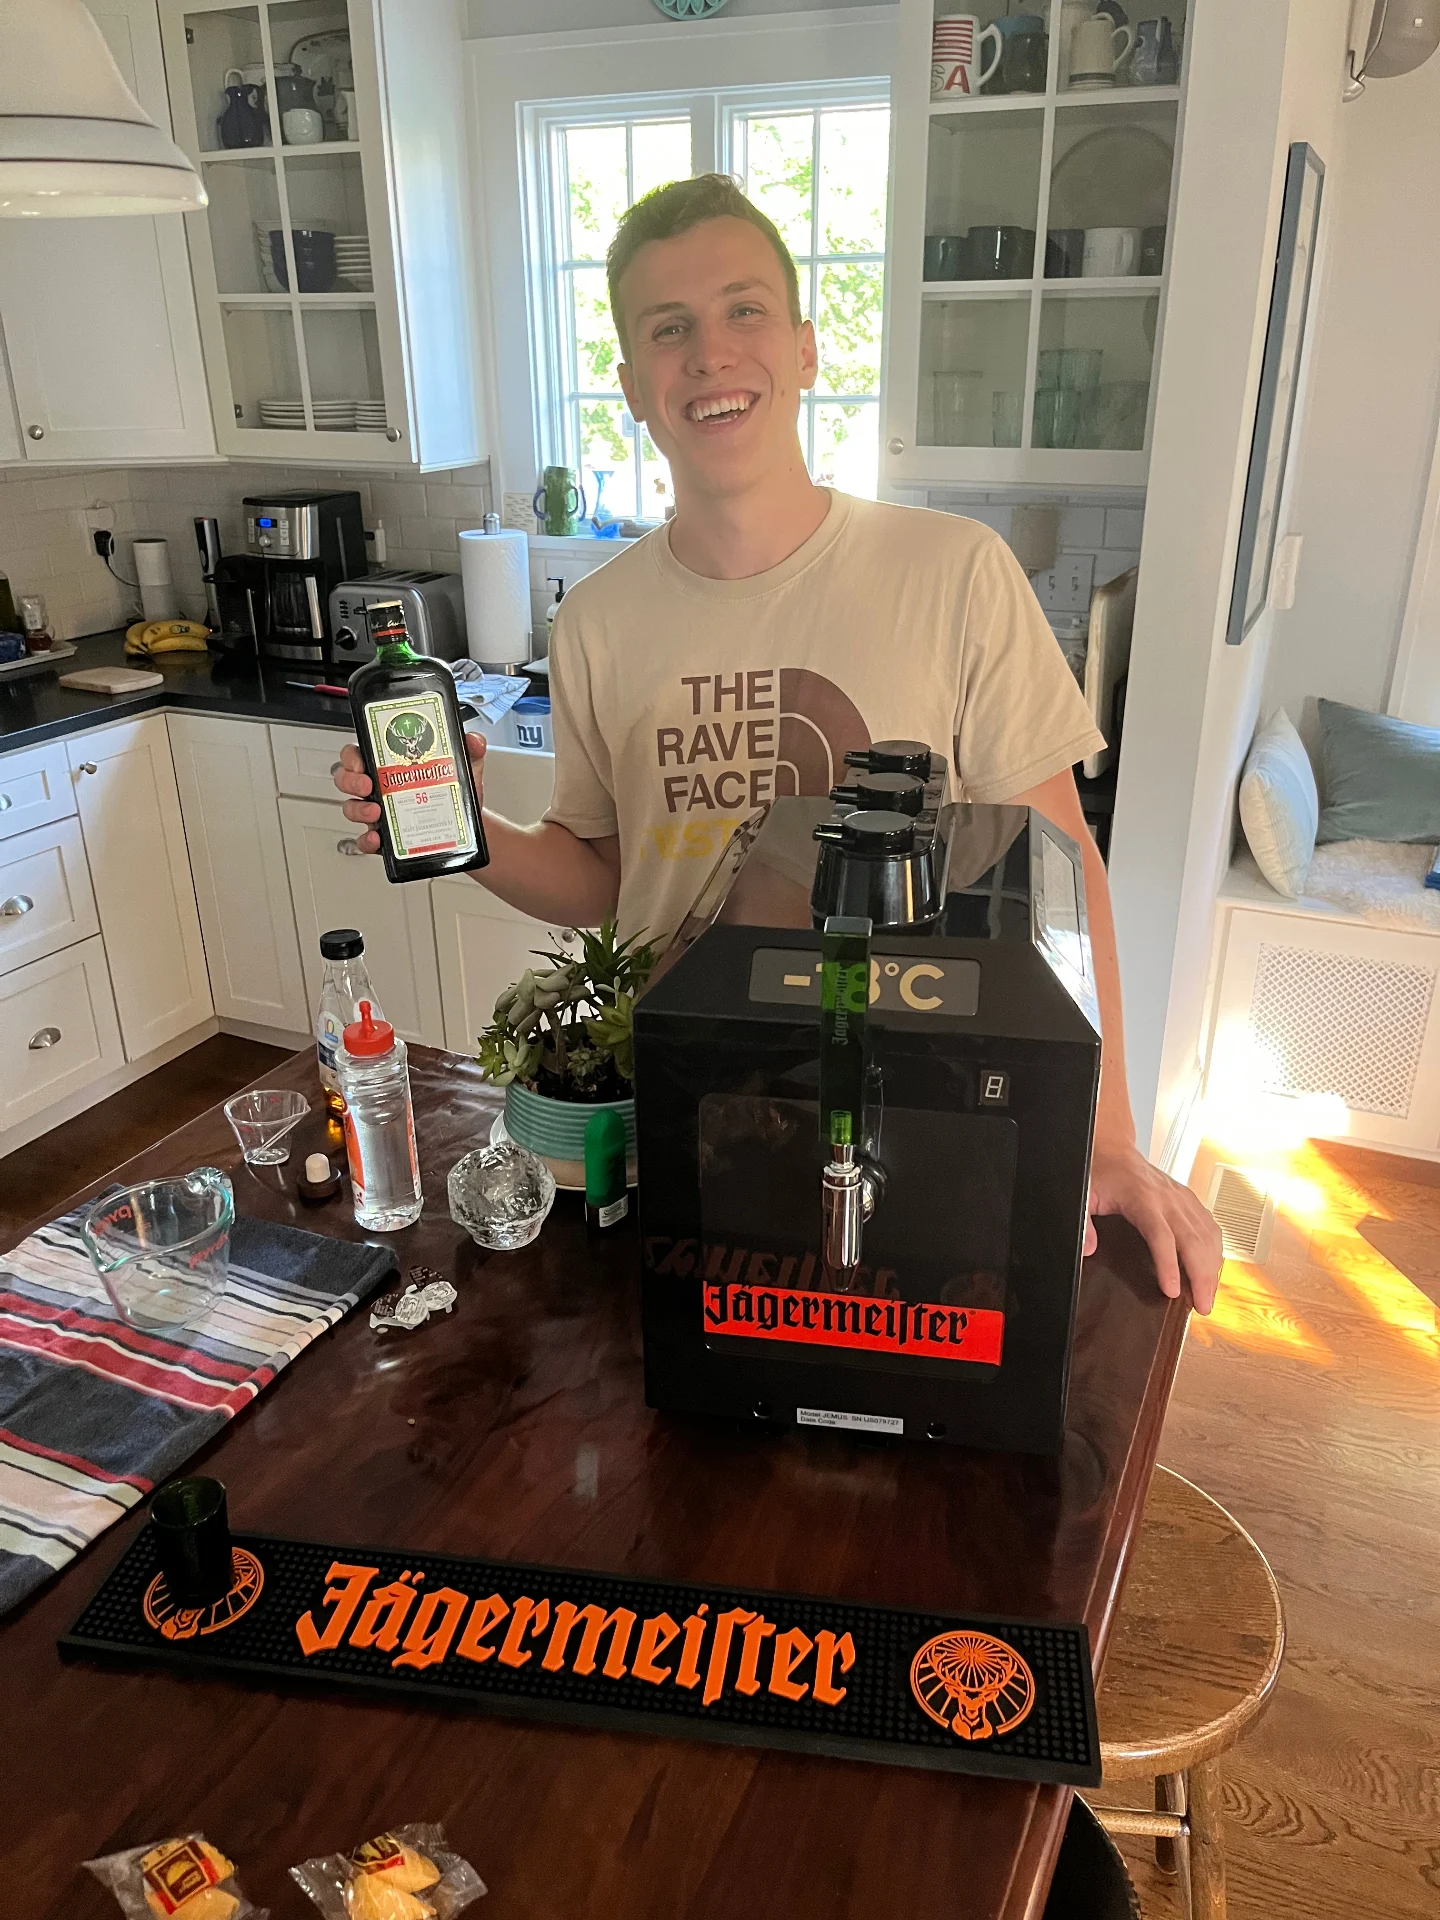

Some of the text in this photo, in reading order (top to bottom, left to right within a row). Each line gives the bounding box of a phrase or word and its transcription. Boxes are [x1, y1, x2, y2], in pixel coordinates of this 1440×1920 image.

[681, 669, 775, 715] THE
[656, 719, 775, 767] RAVE
[415, 792, 429, 805] 56
[663, 769, 774, 813] FACE
